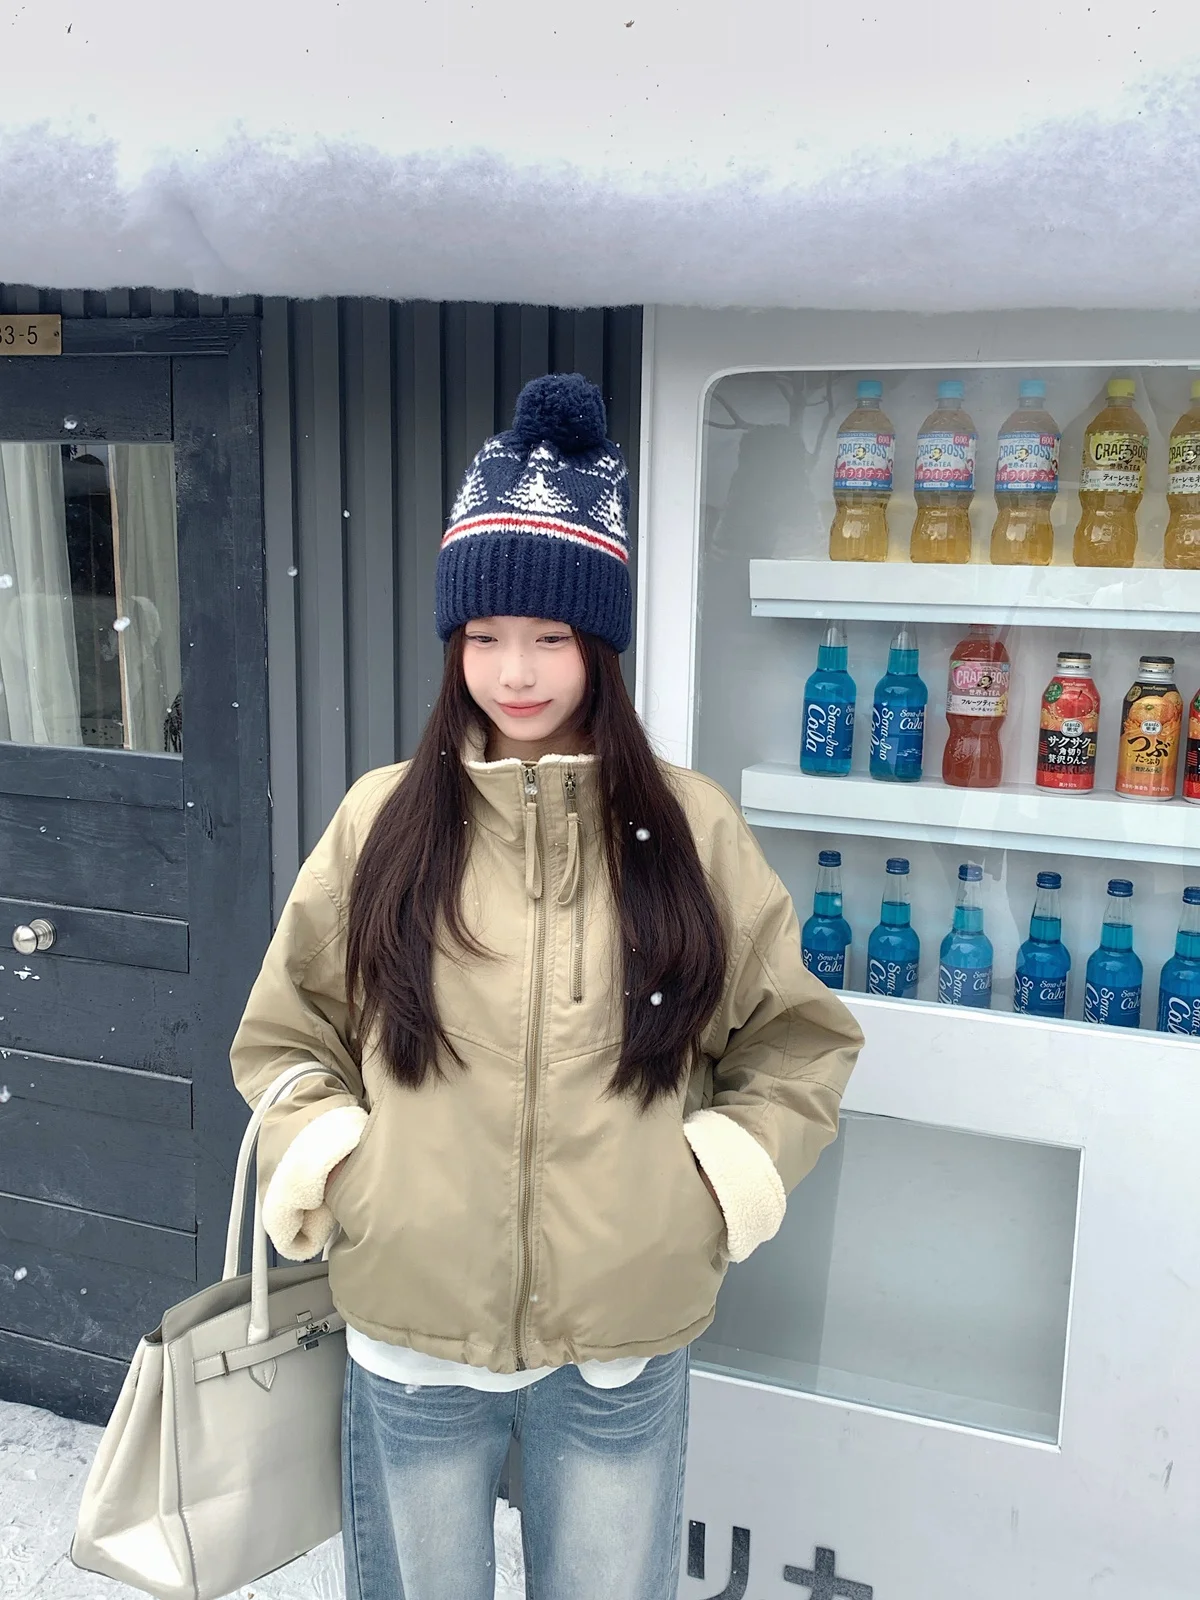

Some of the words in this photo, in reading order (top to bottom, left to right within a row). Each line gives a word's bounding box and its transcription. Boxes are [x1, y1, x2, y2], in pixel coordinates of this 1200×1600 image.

[0, 325, 38, 345] 3-5
[865, 443, 887, 459] BOSS
[941, 444, 965, 460] BOSS
[1027, 445, 1052, 461] BOSS
[1095, 442, 1130, 461] CRAFT
[956, 670, 988, 687] CRAFT
[806, 703, 826, 753] Cola
[1048, 735, 1092, 749] サクサク
[1127, 736, 1170, 758] つぶ
[1048, 754, 1090, 765] 贅沢りんご
[1058, 747, 1081, 756] 角切り
[818, 960, 842, 973] Cola
[1040, 988, 1065, 1001] Cola
